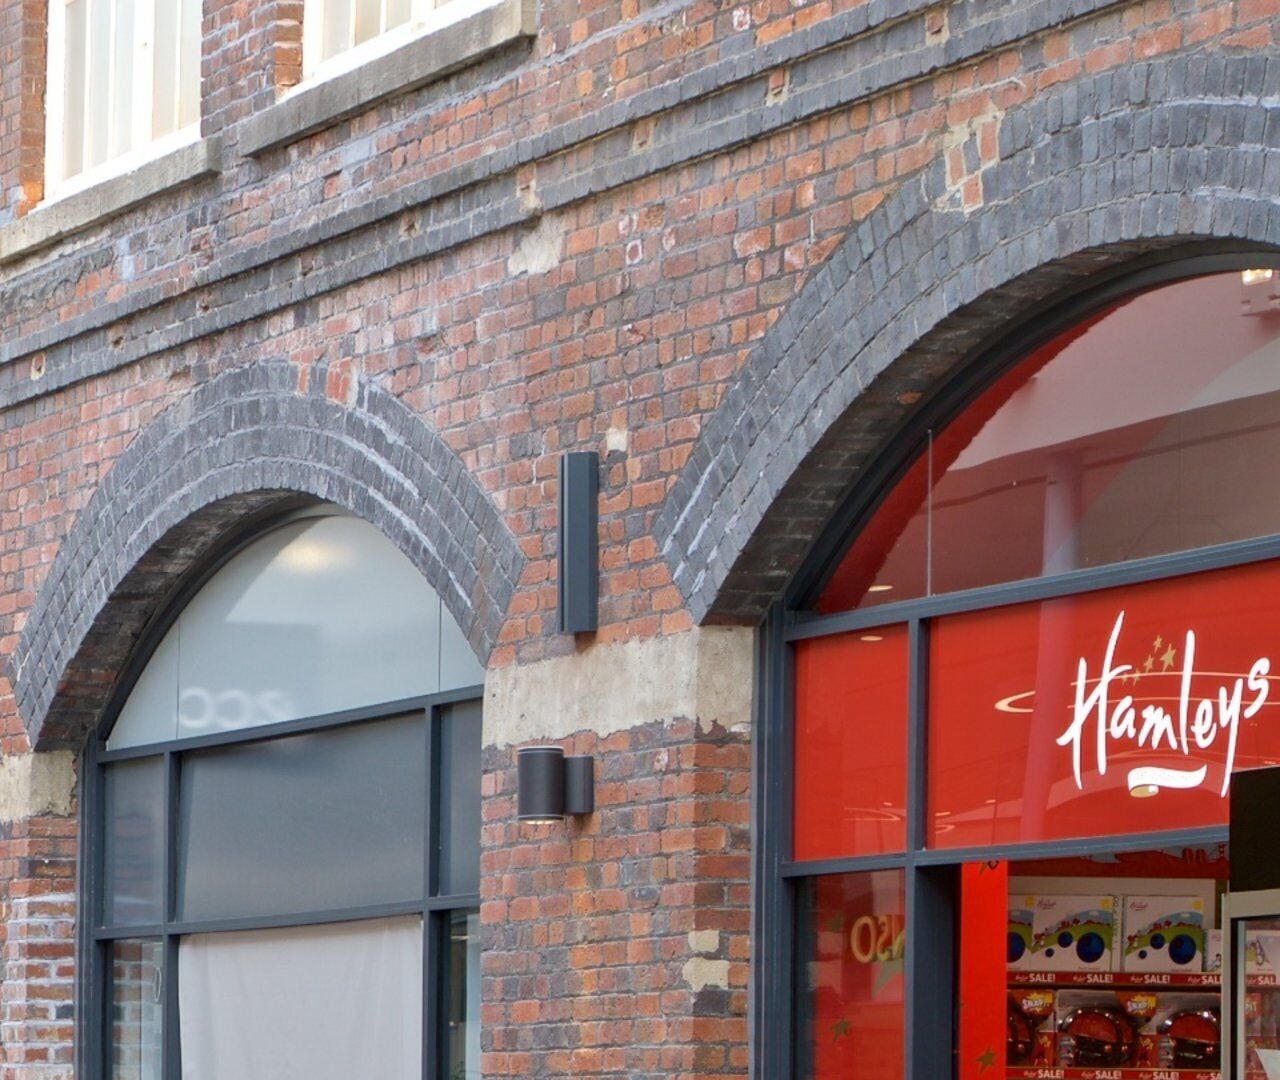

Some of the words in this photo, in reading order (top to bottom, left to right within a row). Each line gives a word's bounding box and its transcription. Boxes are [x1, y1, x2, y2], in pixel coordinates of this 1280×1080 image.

[1056, 610, 1271, 798] Hamleys
[1029, 974, 1056, 983] SALE!
[1087, 974, 1114, 983] SALE!
[1144, 974, 1171, 984] SALE!
[1201, 974, 1222, 985] SAL
[1037, 1070, 1065, 1079] SALE!
[1095, 1070, 1122, 1080] SALE!
[1152, 1071, 1179, 1080] SALE!
